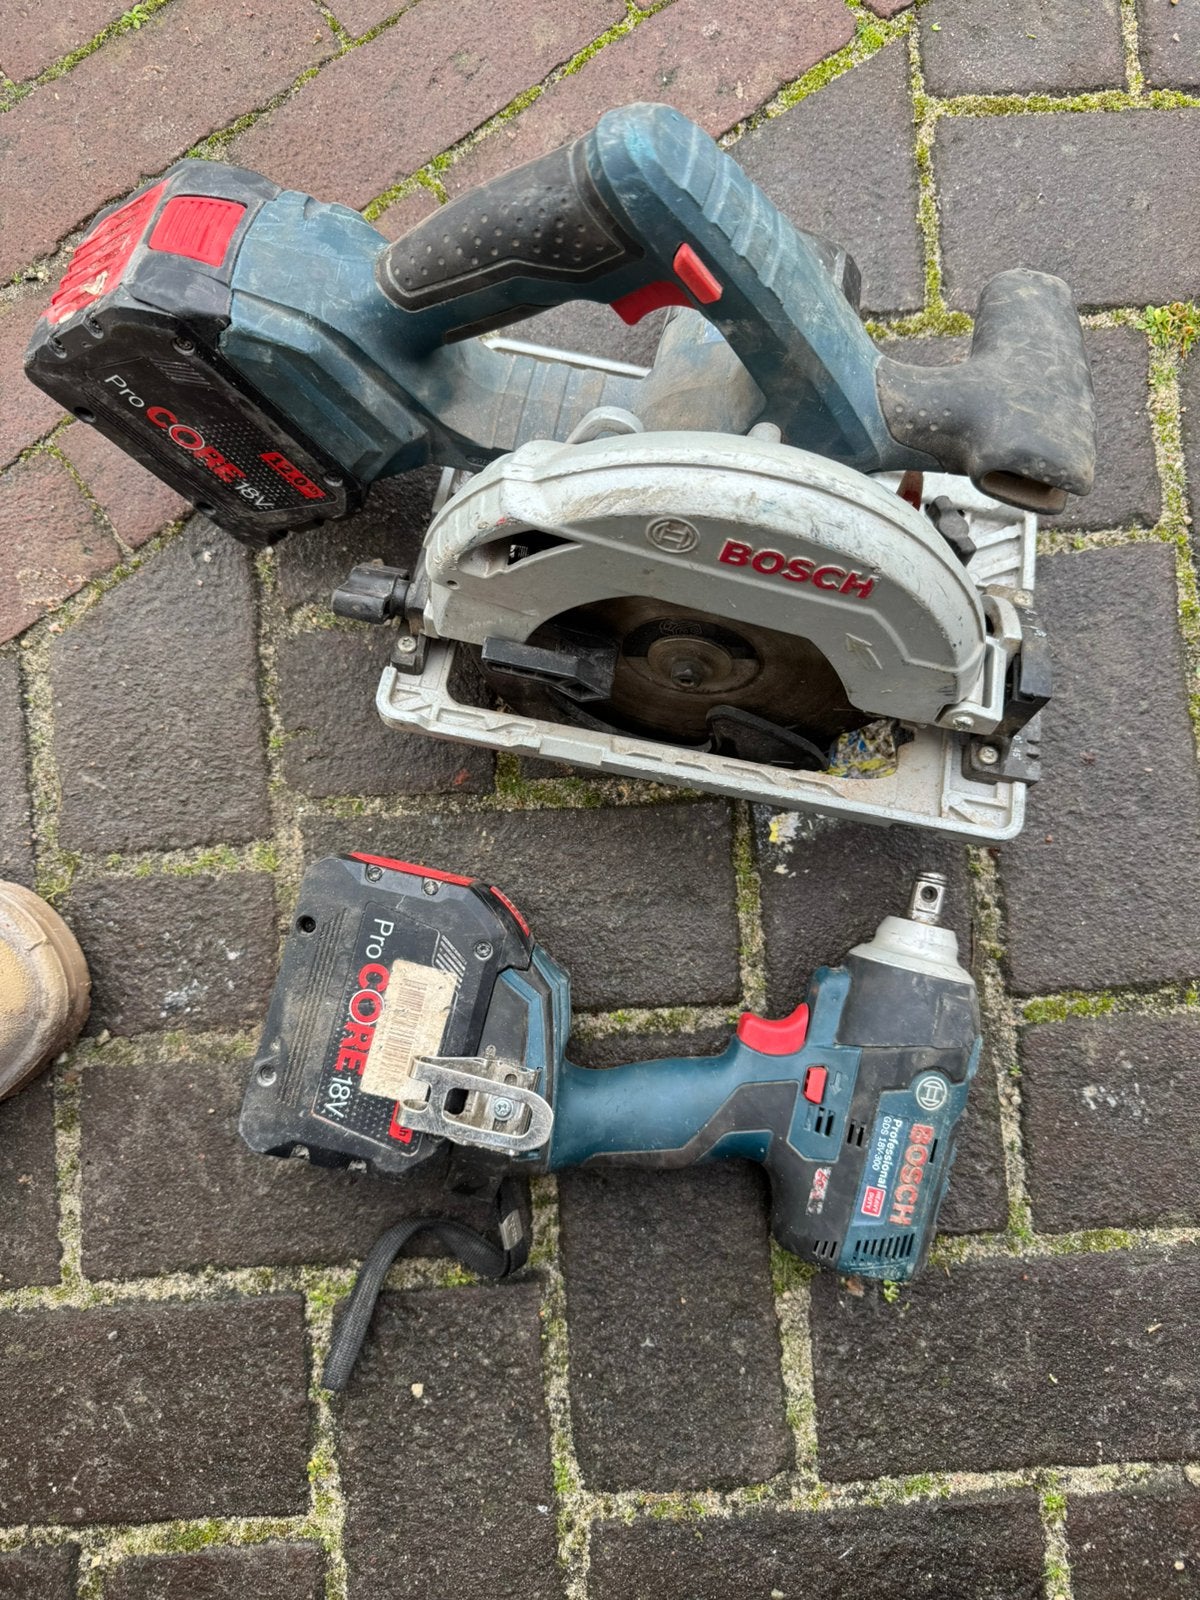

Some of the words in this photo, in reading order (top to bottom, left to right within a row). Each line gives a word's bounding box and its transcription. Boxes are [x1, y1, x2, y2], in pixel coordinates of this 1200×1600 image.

[235, 481, 275, 509] 18V
[717, 538, 880, 599] BOSCH
[325, 1076, 353, 1119] 18V
[880, 1115, 892, 1136] GDS
[872, 1137, 887, 1171] 18V-300
[877, 1118, 903, 1189] Professional
[889, 1123, 935, 1225] BOSCH
[865, 1191, 875, 1210] DUTY
[873, 1190, 884, 1213] HEAVY
